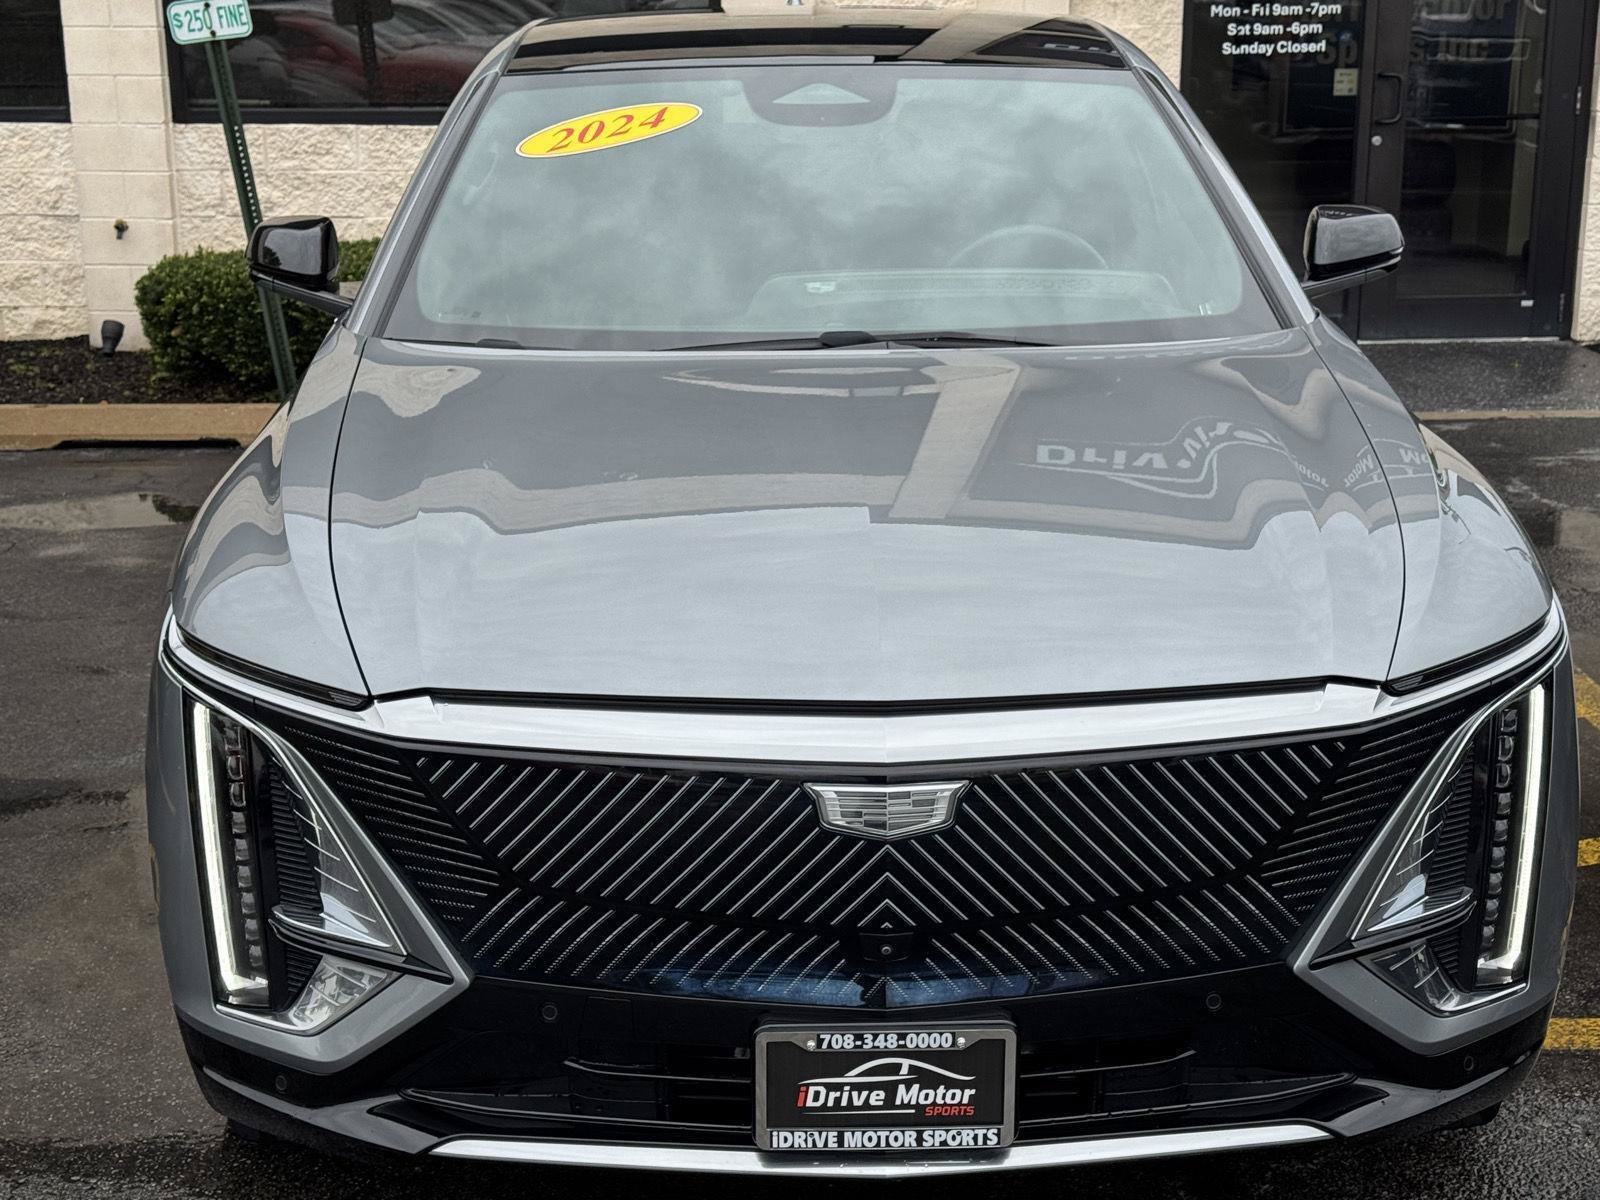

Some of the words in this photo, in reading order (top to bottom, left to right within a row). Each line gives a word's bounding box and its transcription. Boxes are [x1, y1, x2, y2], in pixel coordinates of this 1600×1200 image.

[216, 4, 247, 29] FINE
[1210, 4, 1240, 17] Mon
[1251, 3, 1270, 16] Fri
[1272, 3, 1303, 16] 9am
[1227, 23, 1250, 36] Sat
[1253, 23, 1284, 35] 9am
[1222, 42, 1274, 56] Sunday
[1276, 40, 1326, 54] Closed
[547, 106, 668, 152] 2024
[819, 1032, 953, 1049] 708-348-0000
[797, 1085, 885, 1107] iDrive
[895, 1083, 976, 1105] Motor
[925, 1106, 975, 1116] SPORTS
[772, 1131, 838, 1148] iDRIVE
[844, 1130, 918, 1148] MOTOR
[922, 1129, 998, 1147] SPORTS
